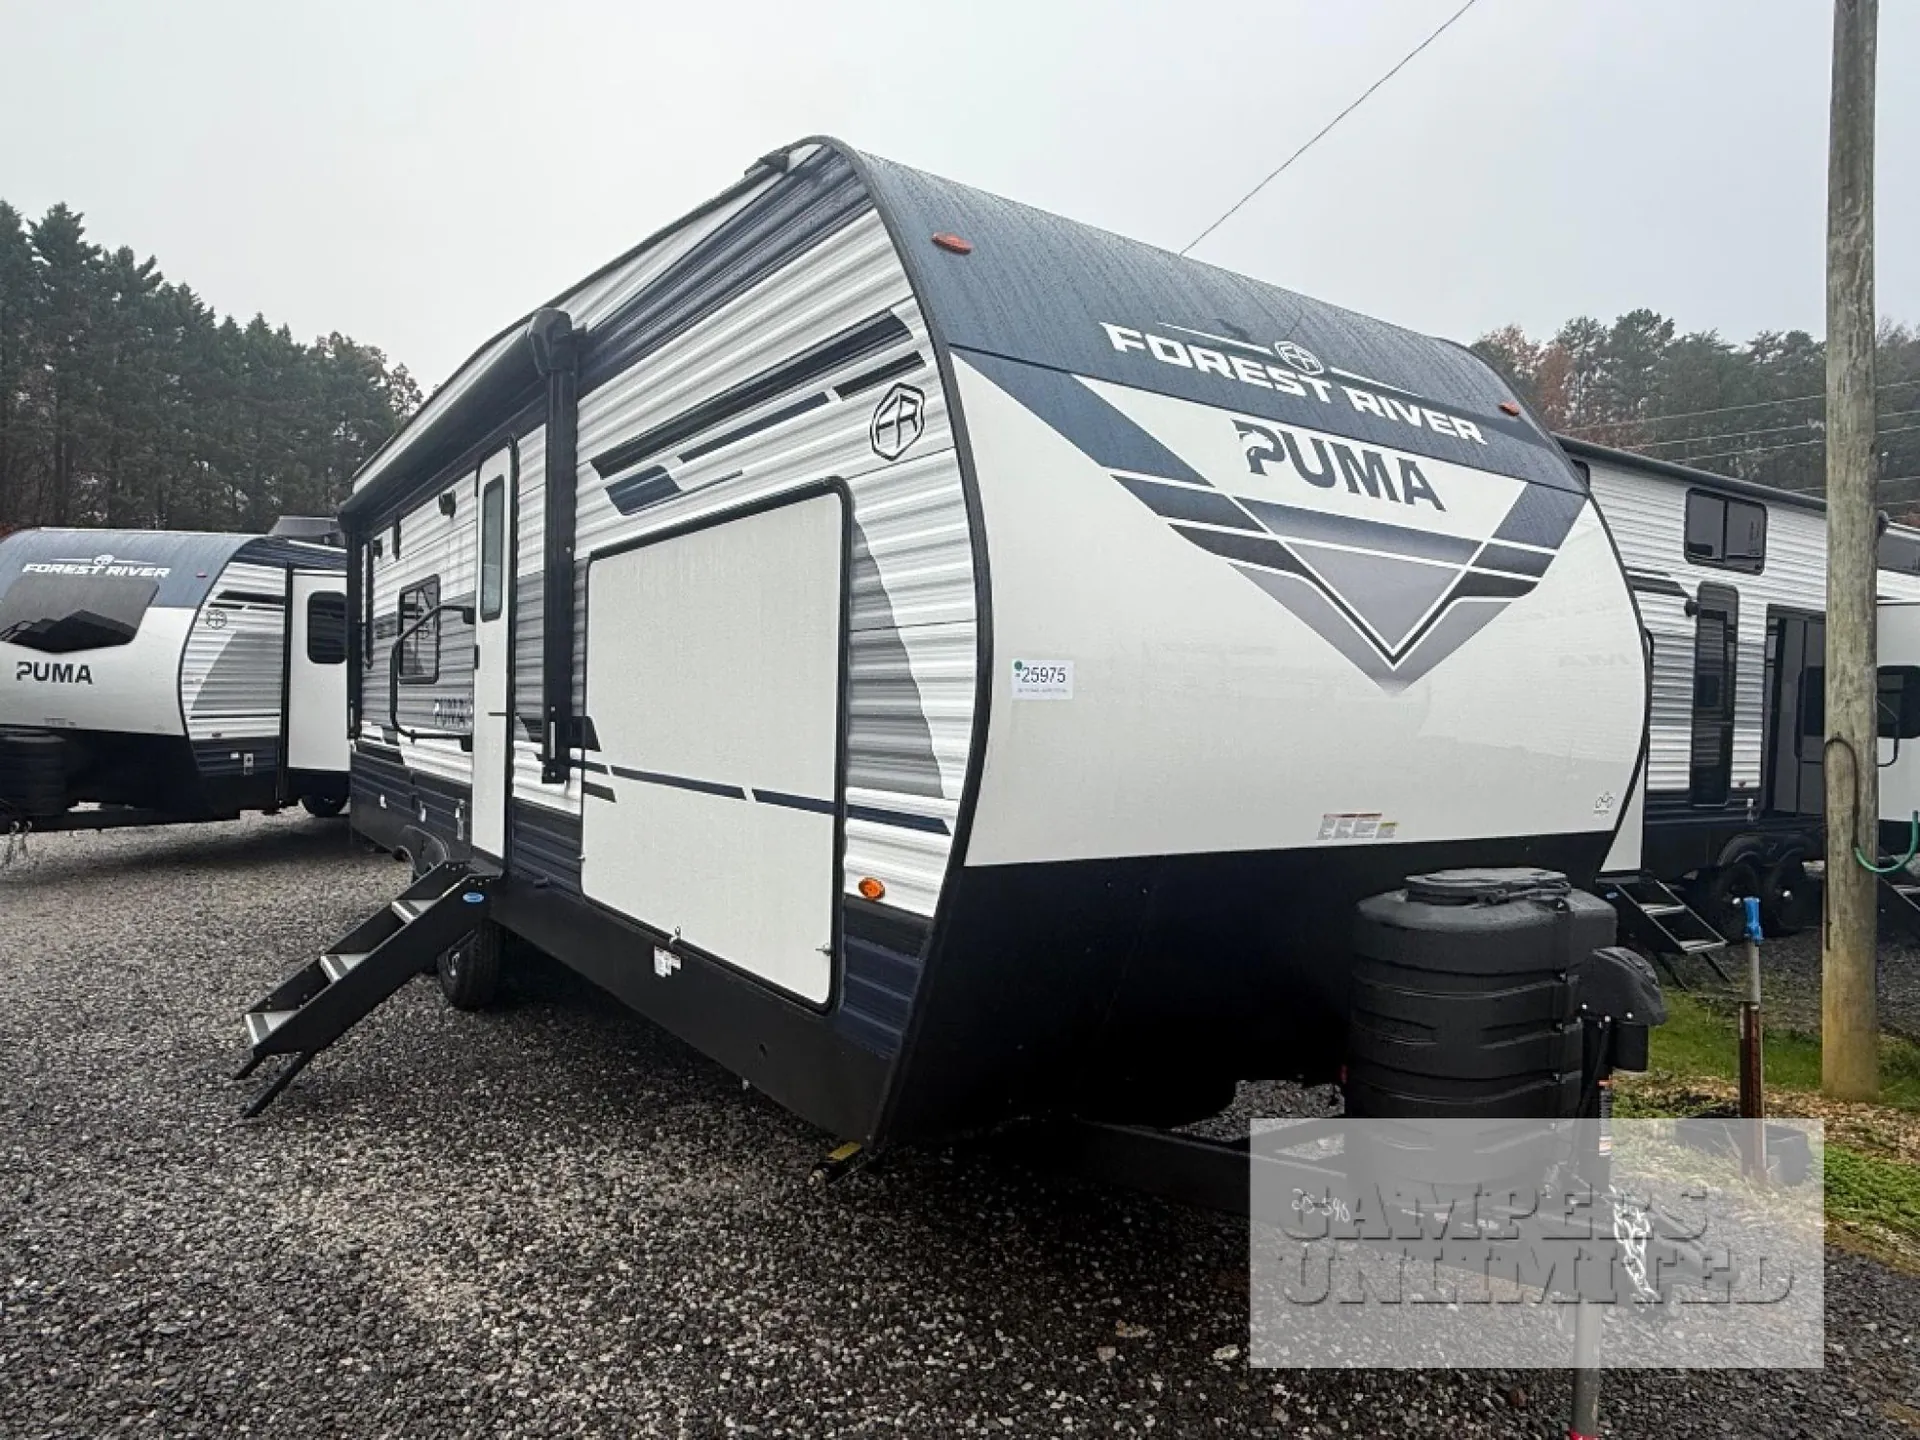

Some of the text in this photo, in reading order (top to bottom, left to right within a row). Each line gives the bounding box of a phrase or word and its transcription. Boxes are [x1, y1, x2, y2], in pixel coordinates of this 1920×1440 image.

[1099, 322, 1487, 444] FOREST RIVER
[1231, 418, 1446, 512] PUMA
[22, 563, 171, 578] FOREST RIVER
[16, 661, 93, 684] PUMA
[1021, 666, 1066, 683] 25975
